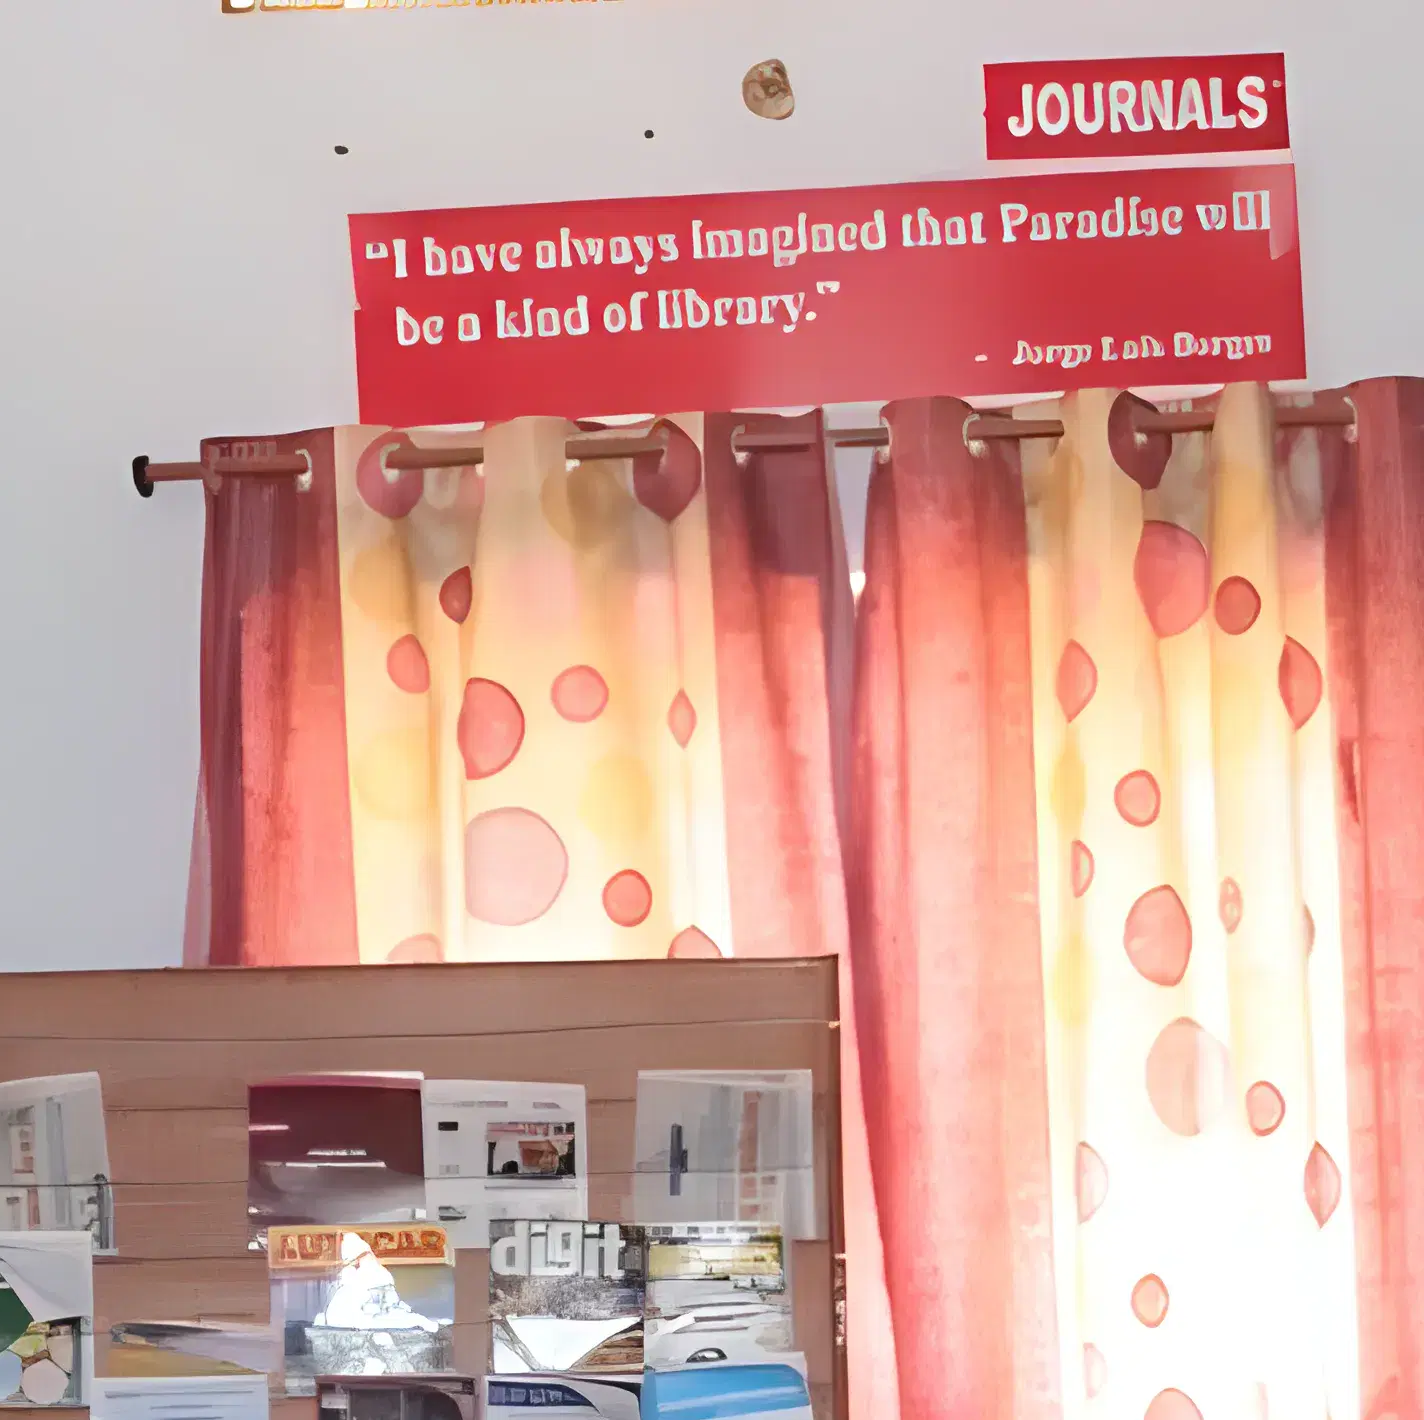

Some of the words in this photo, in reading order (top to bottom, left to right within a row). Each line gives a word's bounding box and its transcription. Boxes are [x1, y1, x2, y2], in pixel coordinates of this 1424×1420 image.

[1007, 76, 1269, 137] JOURNALS
[902, 207, 987, 248] that
[1196, 189, 1271, 232] will
[395, 305, 445, 346] be
[457, 312, 482, 342] a
[603, 290, 649, 333] of
[490, 1220, 626, 1277] digit
